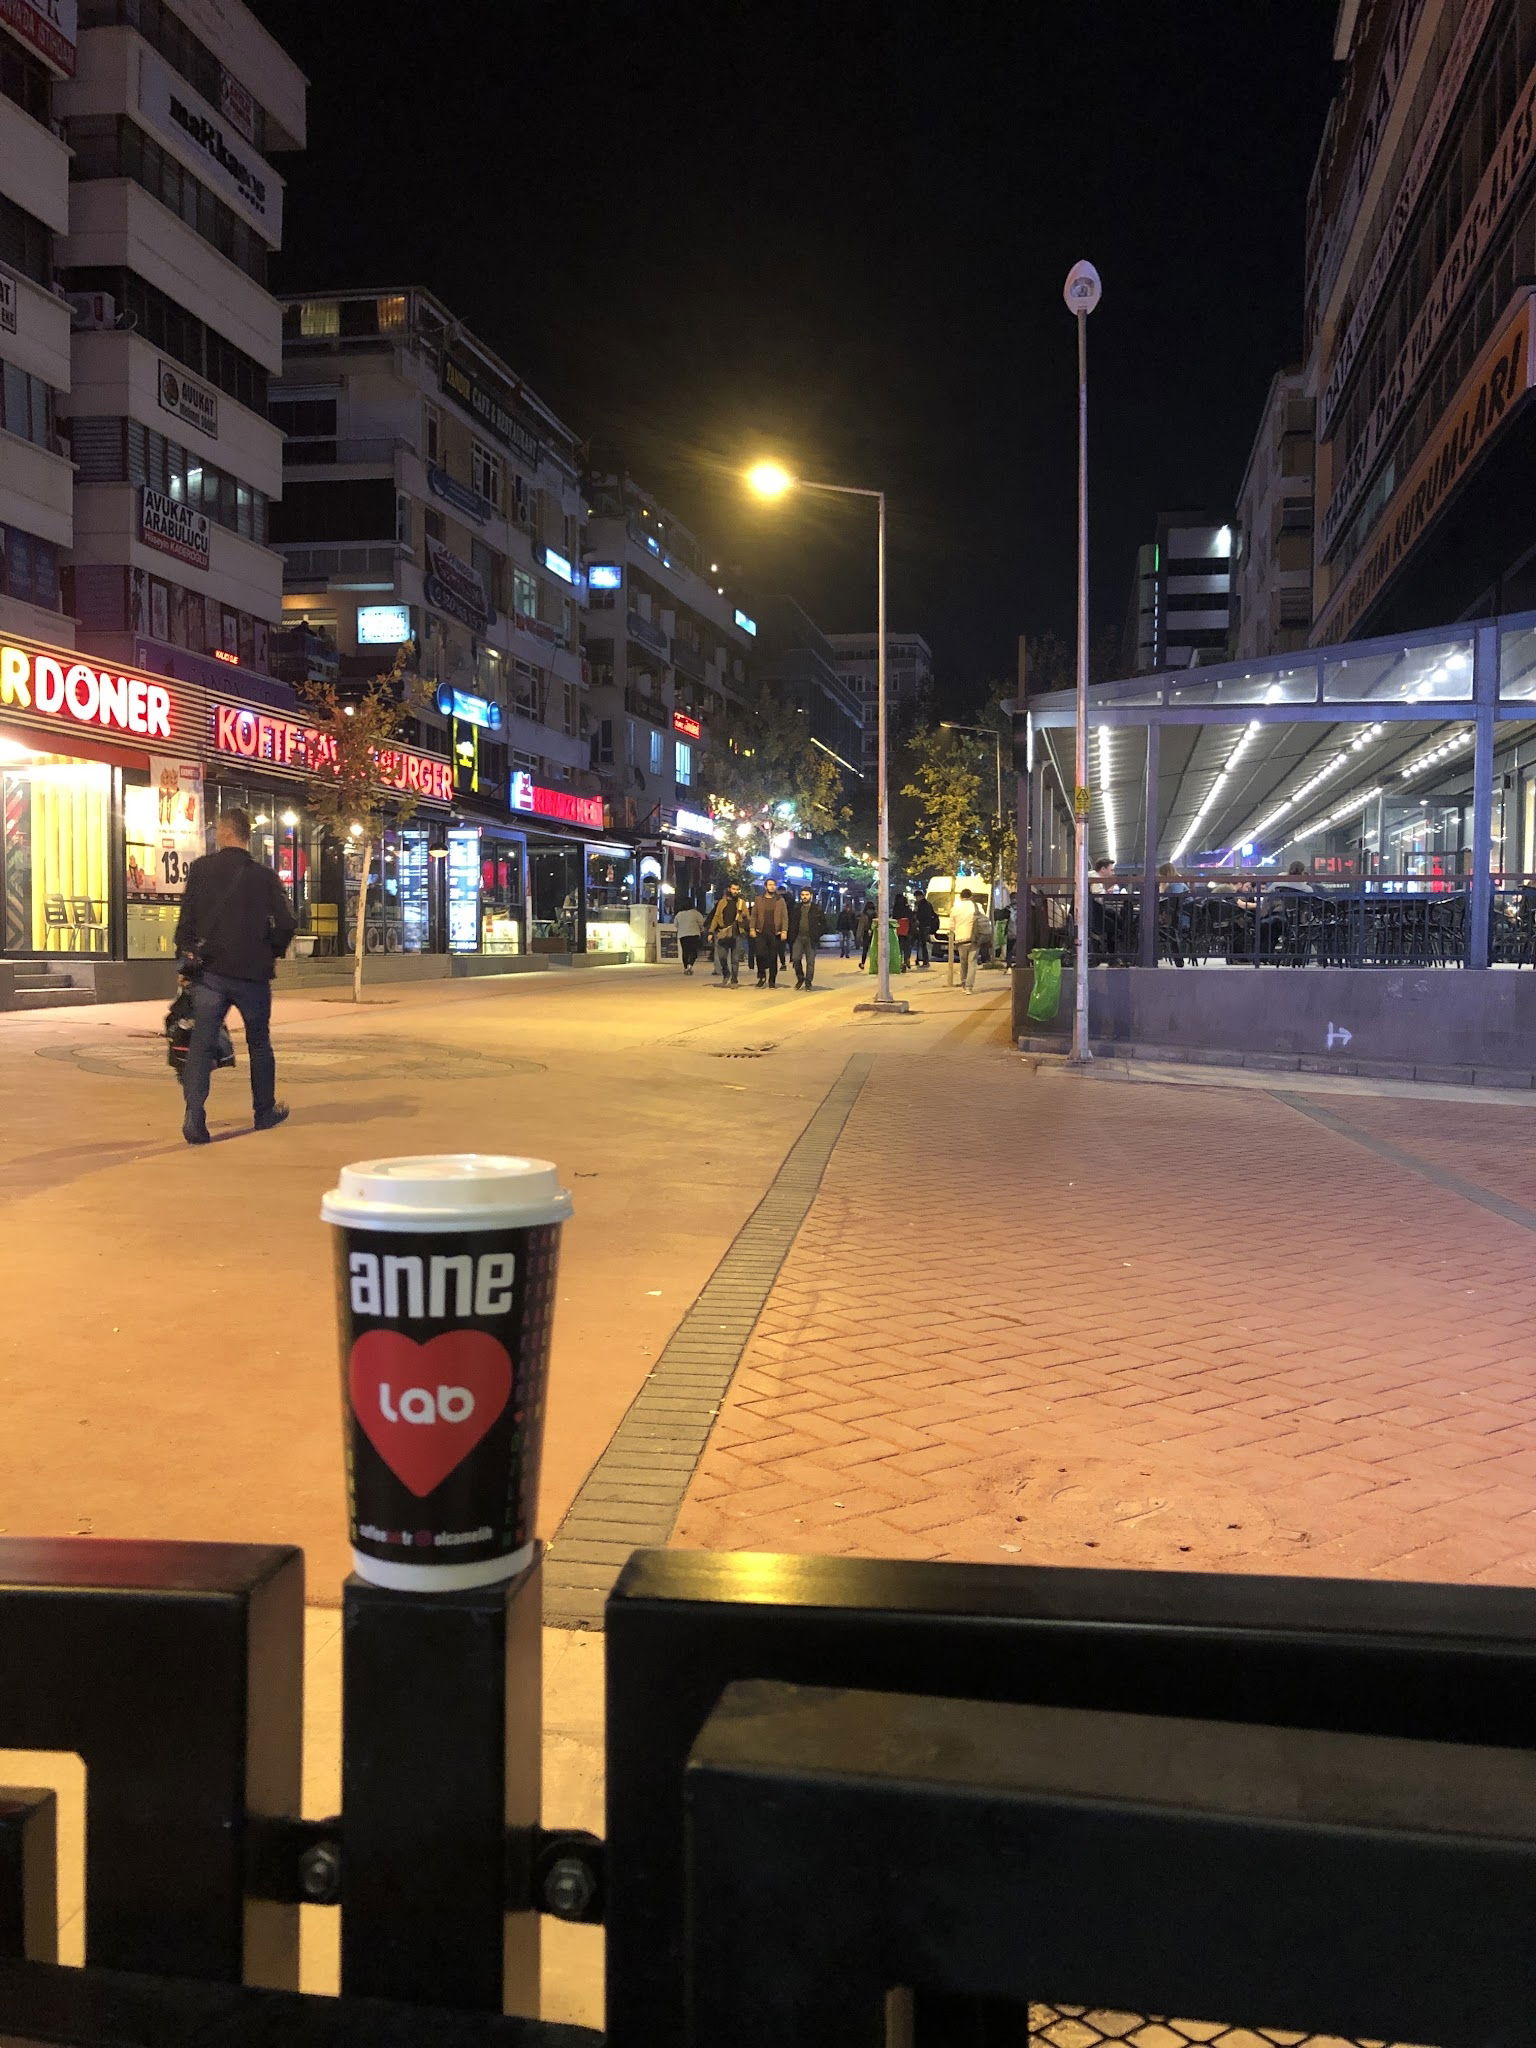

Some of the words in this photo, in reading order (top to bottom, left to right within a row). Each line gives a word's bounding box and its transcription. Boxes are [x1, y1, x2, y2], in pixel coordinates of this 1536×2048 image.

[1393, 329, 1524, 562] KURUMLARI
[145, 491, 194, 528] AVUKAT
[145, 510, 208, 553] ARABULUCU
[35, 656, 171, 737] DÖNER
[161, 850, 195, 885] 13.9
[349, 1251, 516, 1319] anne
[379, 1382, 475, 1425] lab
